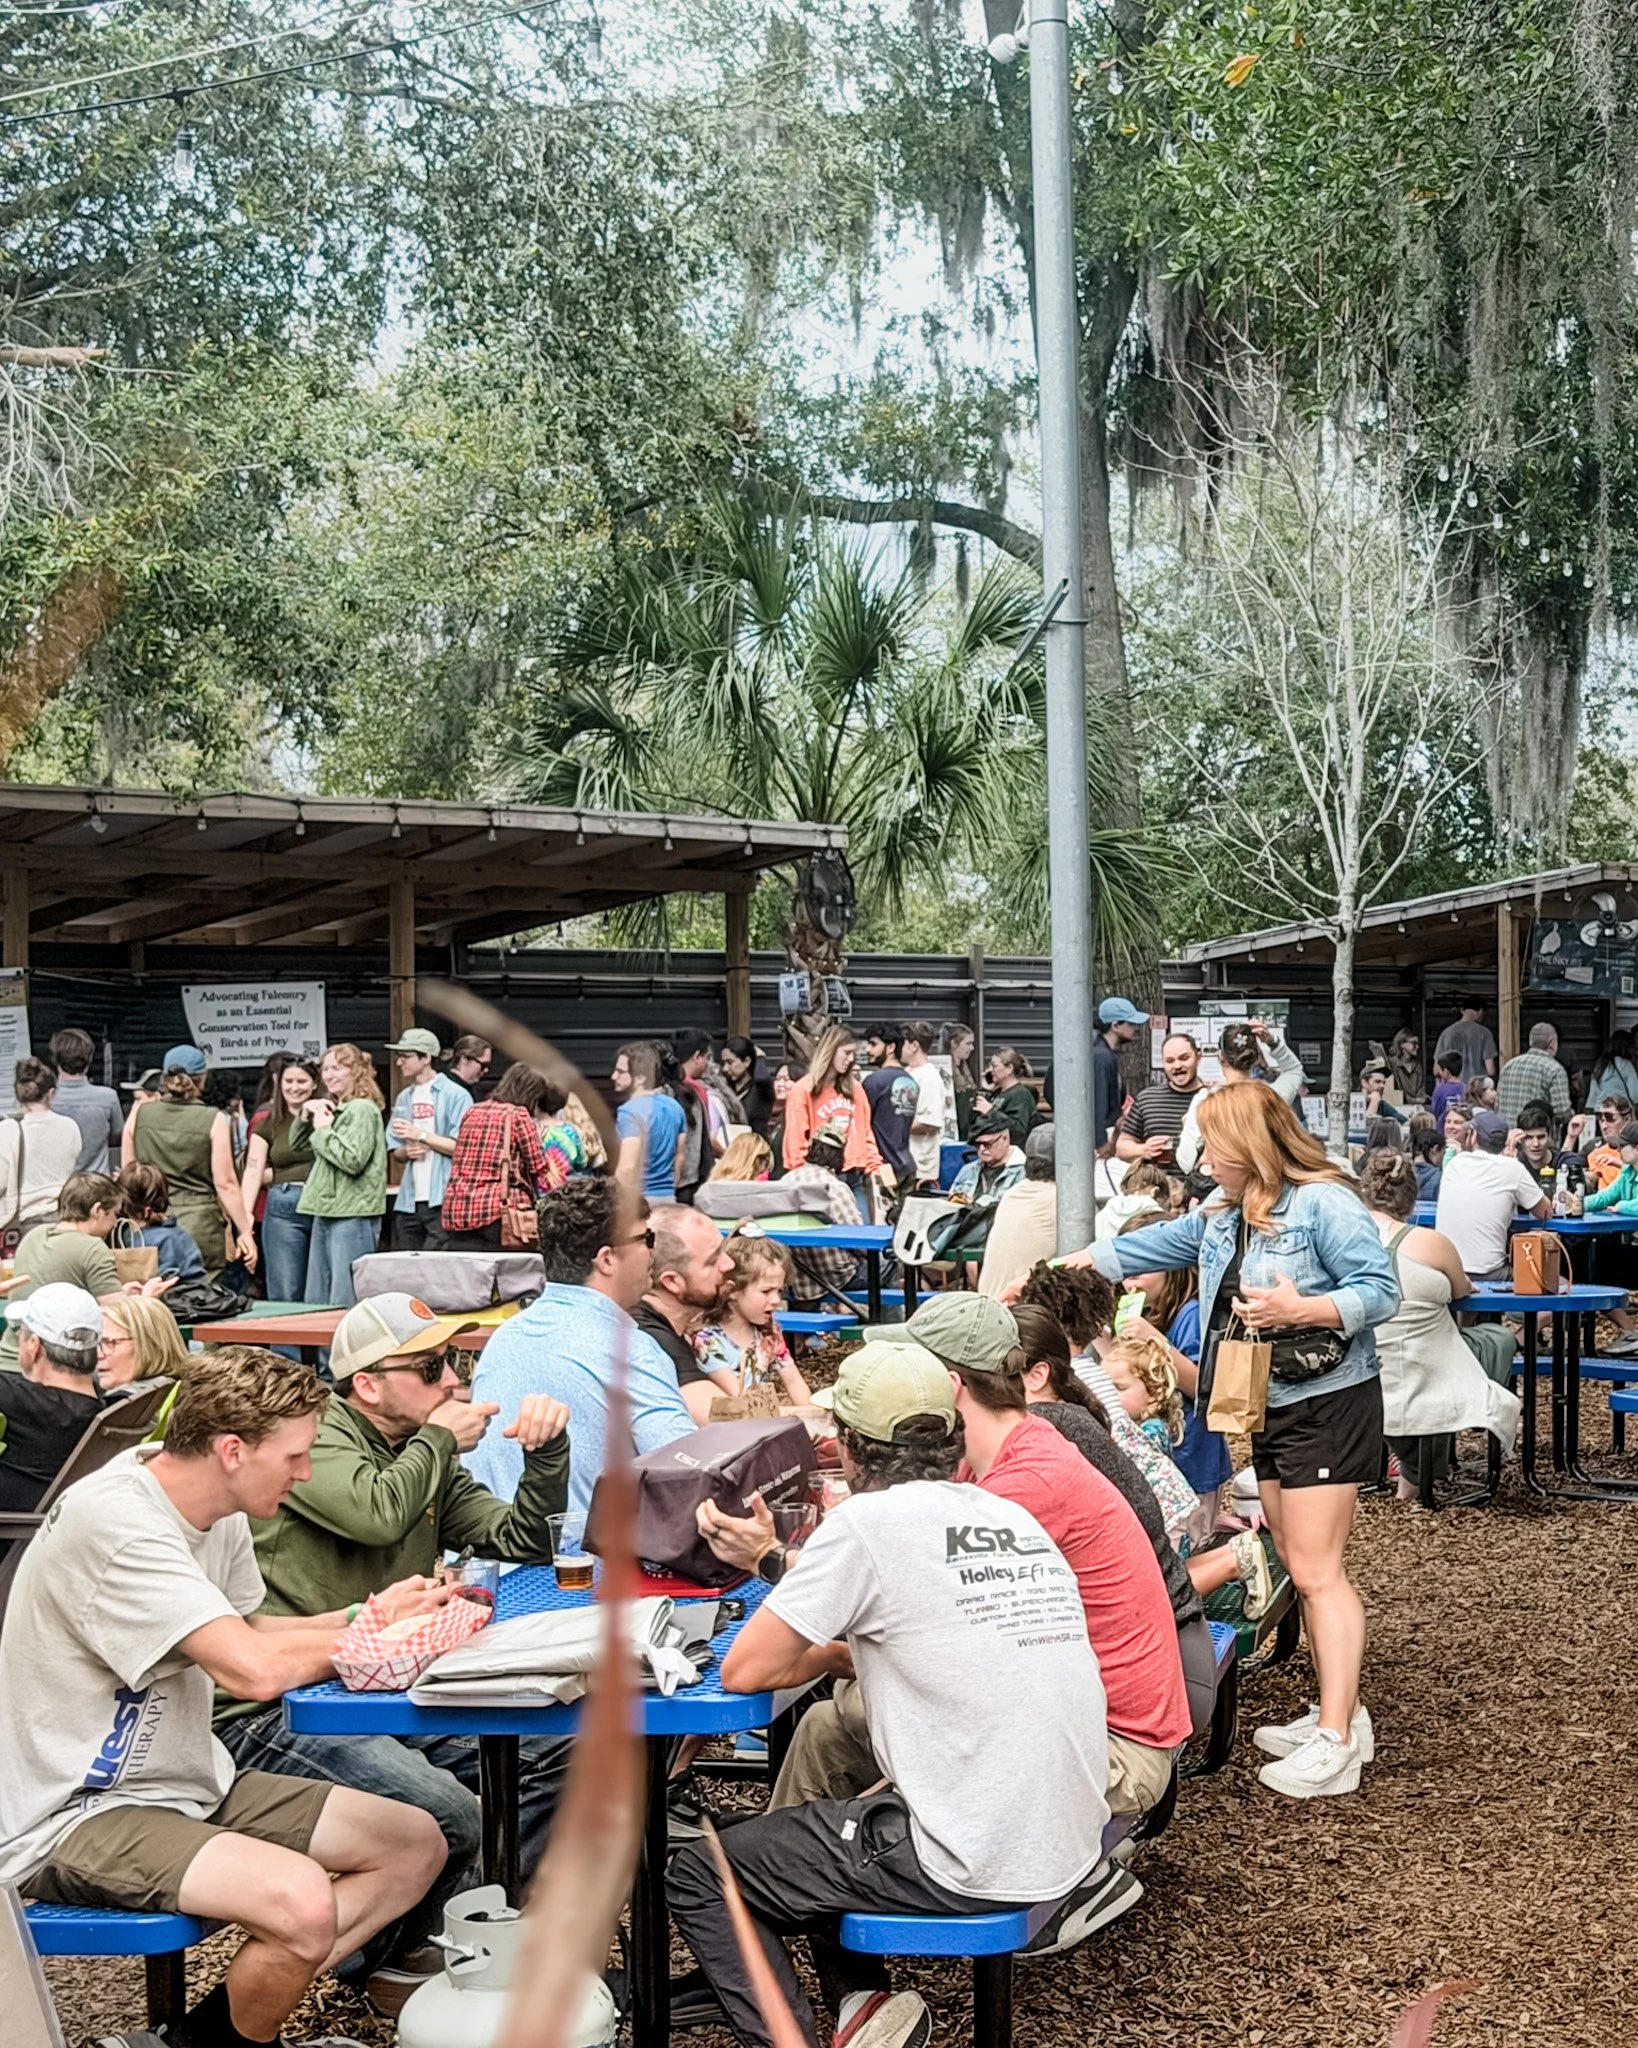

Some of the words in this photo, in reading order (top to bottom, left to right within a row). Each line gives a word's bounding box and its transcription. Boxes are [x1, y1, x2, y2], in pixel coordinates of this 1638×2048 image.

[198, 991, 260, 1003] Advocating
[261, 990, 308, 1002] Falconry
[216, 1009, 228, 1017] as
[246, 1005, 292, 1016] Essential
[198, 1021, 268, 1034] Conservation
[270, 1020, 291, 1031] Tool
[293, 1020, 310, 1030] for
[220, 1037, 249, 1048] Birds
[251, 1036, 262, 1047] of
[264, 1036, 289, 1049] Prey
[945, 1525, 1018, 1557] KSR
[959, 1565, 1016, 1586] Holley
[1017, 1563, 1044, 1583] EFI
[955, 1595, 986, 1607] DRAG
[990, 1590, 1017, 1600] RACE
[964, 1603, 1001, 1616] TURBO
[970, 1614, 1006, 1625] CUSTOM
